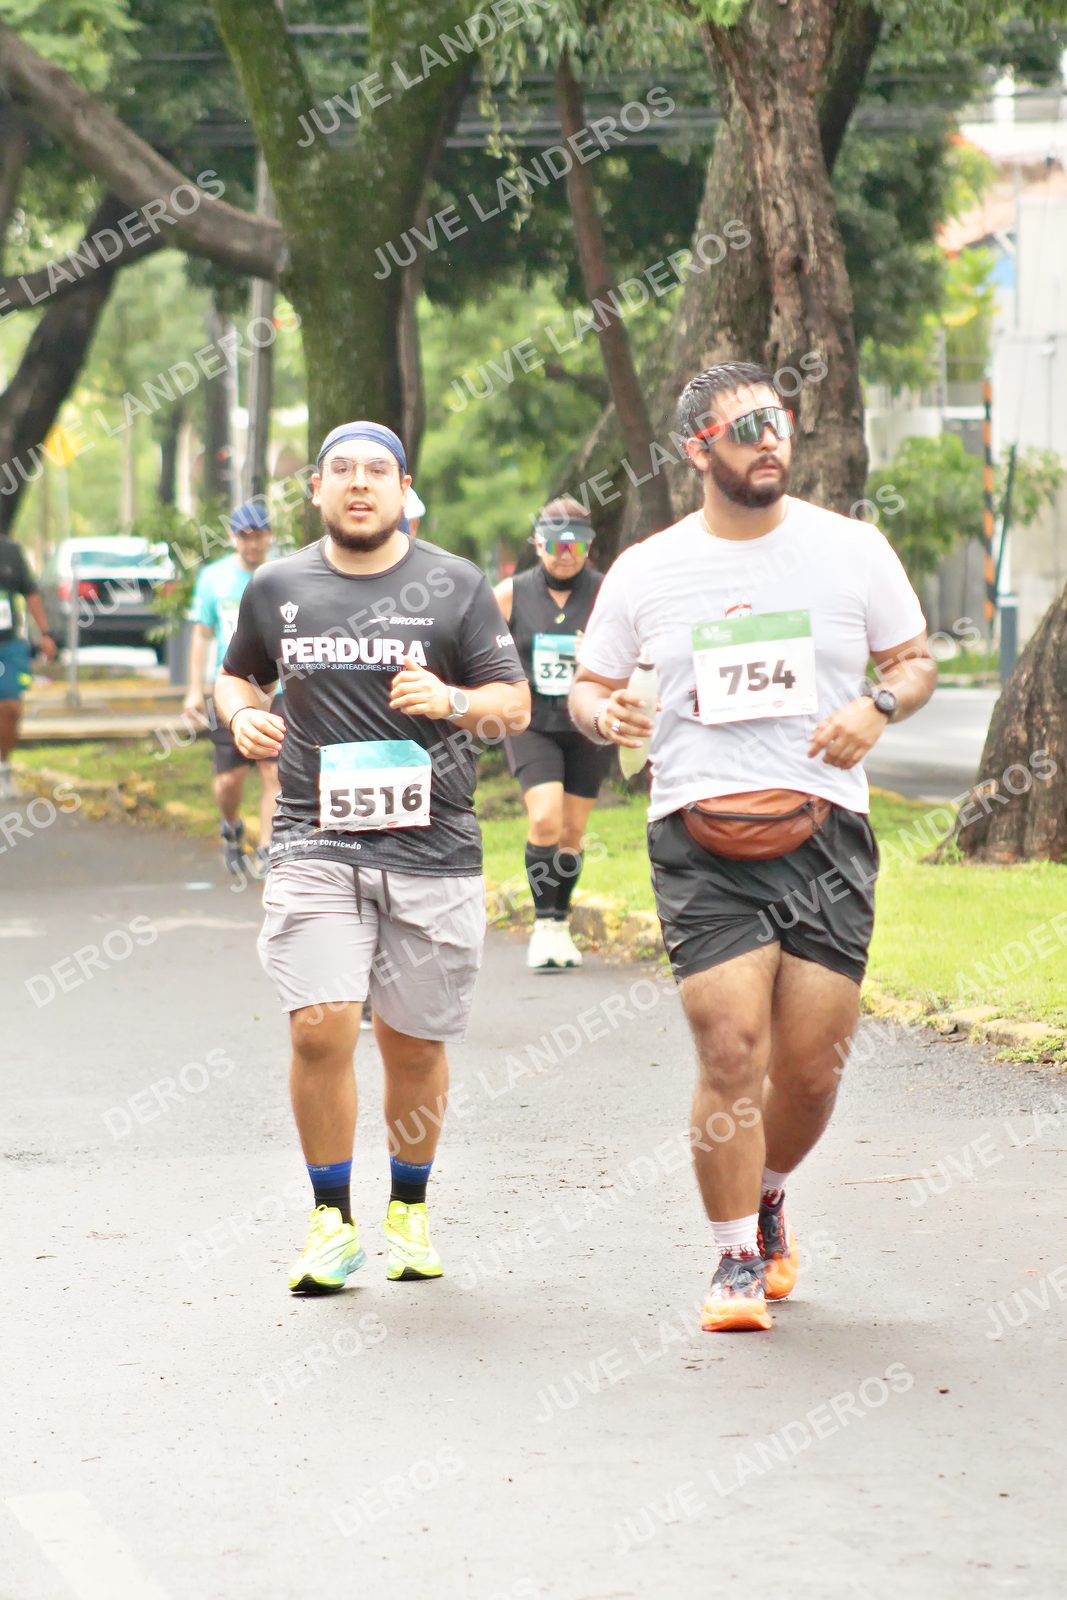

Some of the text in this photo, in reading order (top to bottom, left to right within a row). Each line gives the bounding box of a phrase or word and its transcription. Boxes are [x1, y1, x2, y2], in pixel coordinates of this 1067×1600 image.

[389, 616, 435, 626] BROOKS
[280, 636, 428, 667] PERDURA
[331, 664, 382, 672] JUNTEADORES
[719, 659, 796, 696] 754
[330, 783, 423, 819] 5516
[319, 838, 362, 850] corriendo
